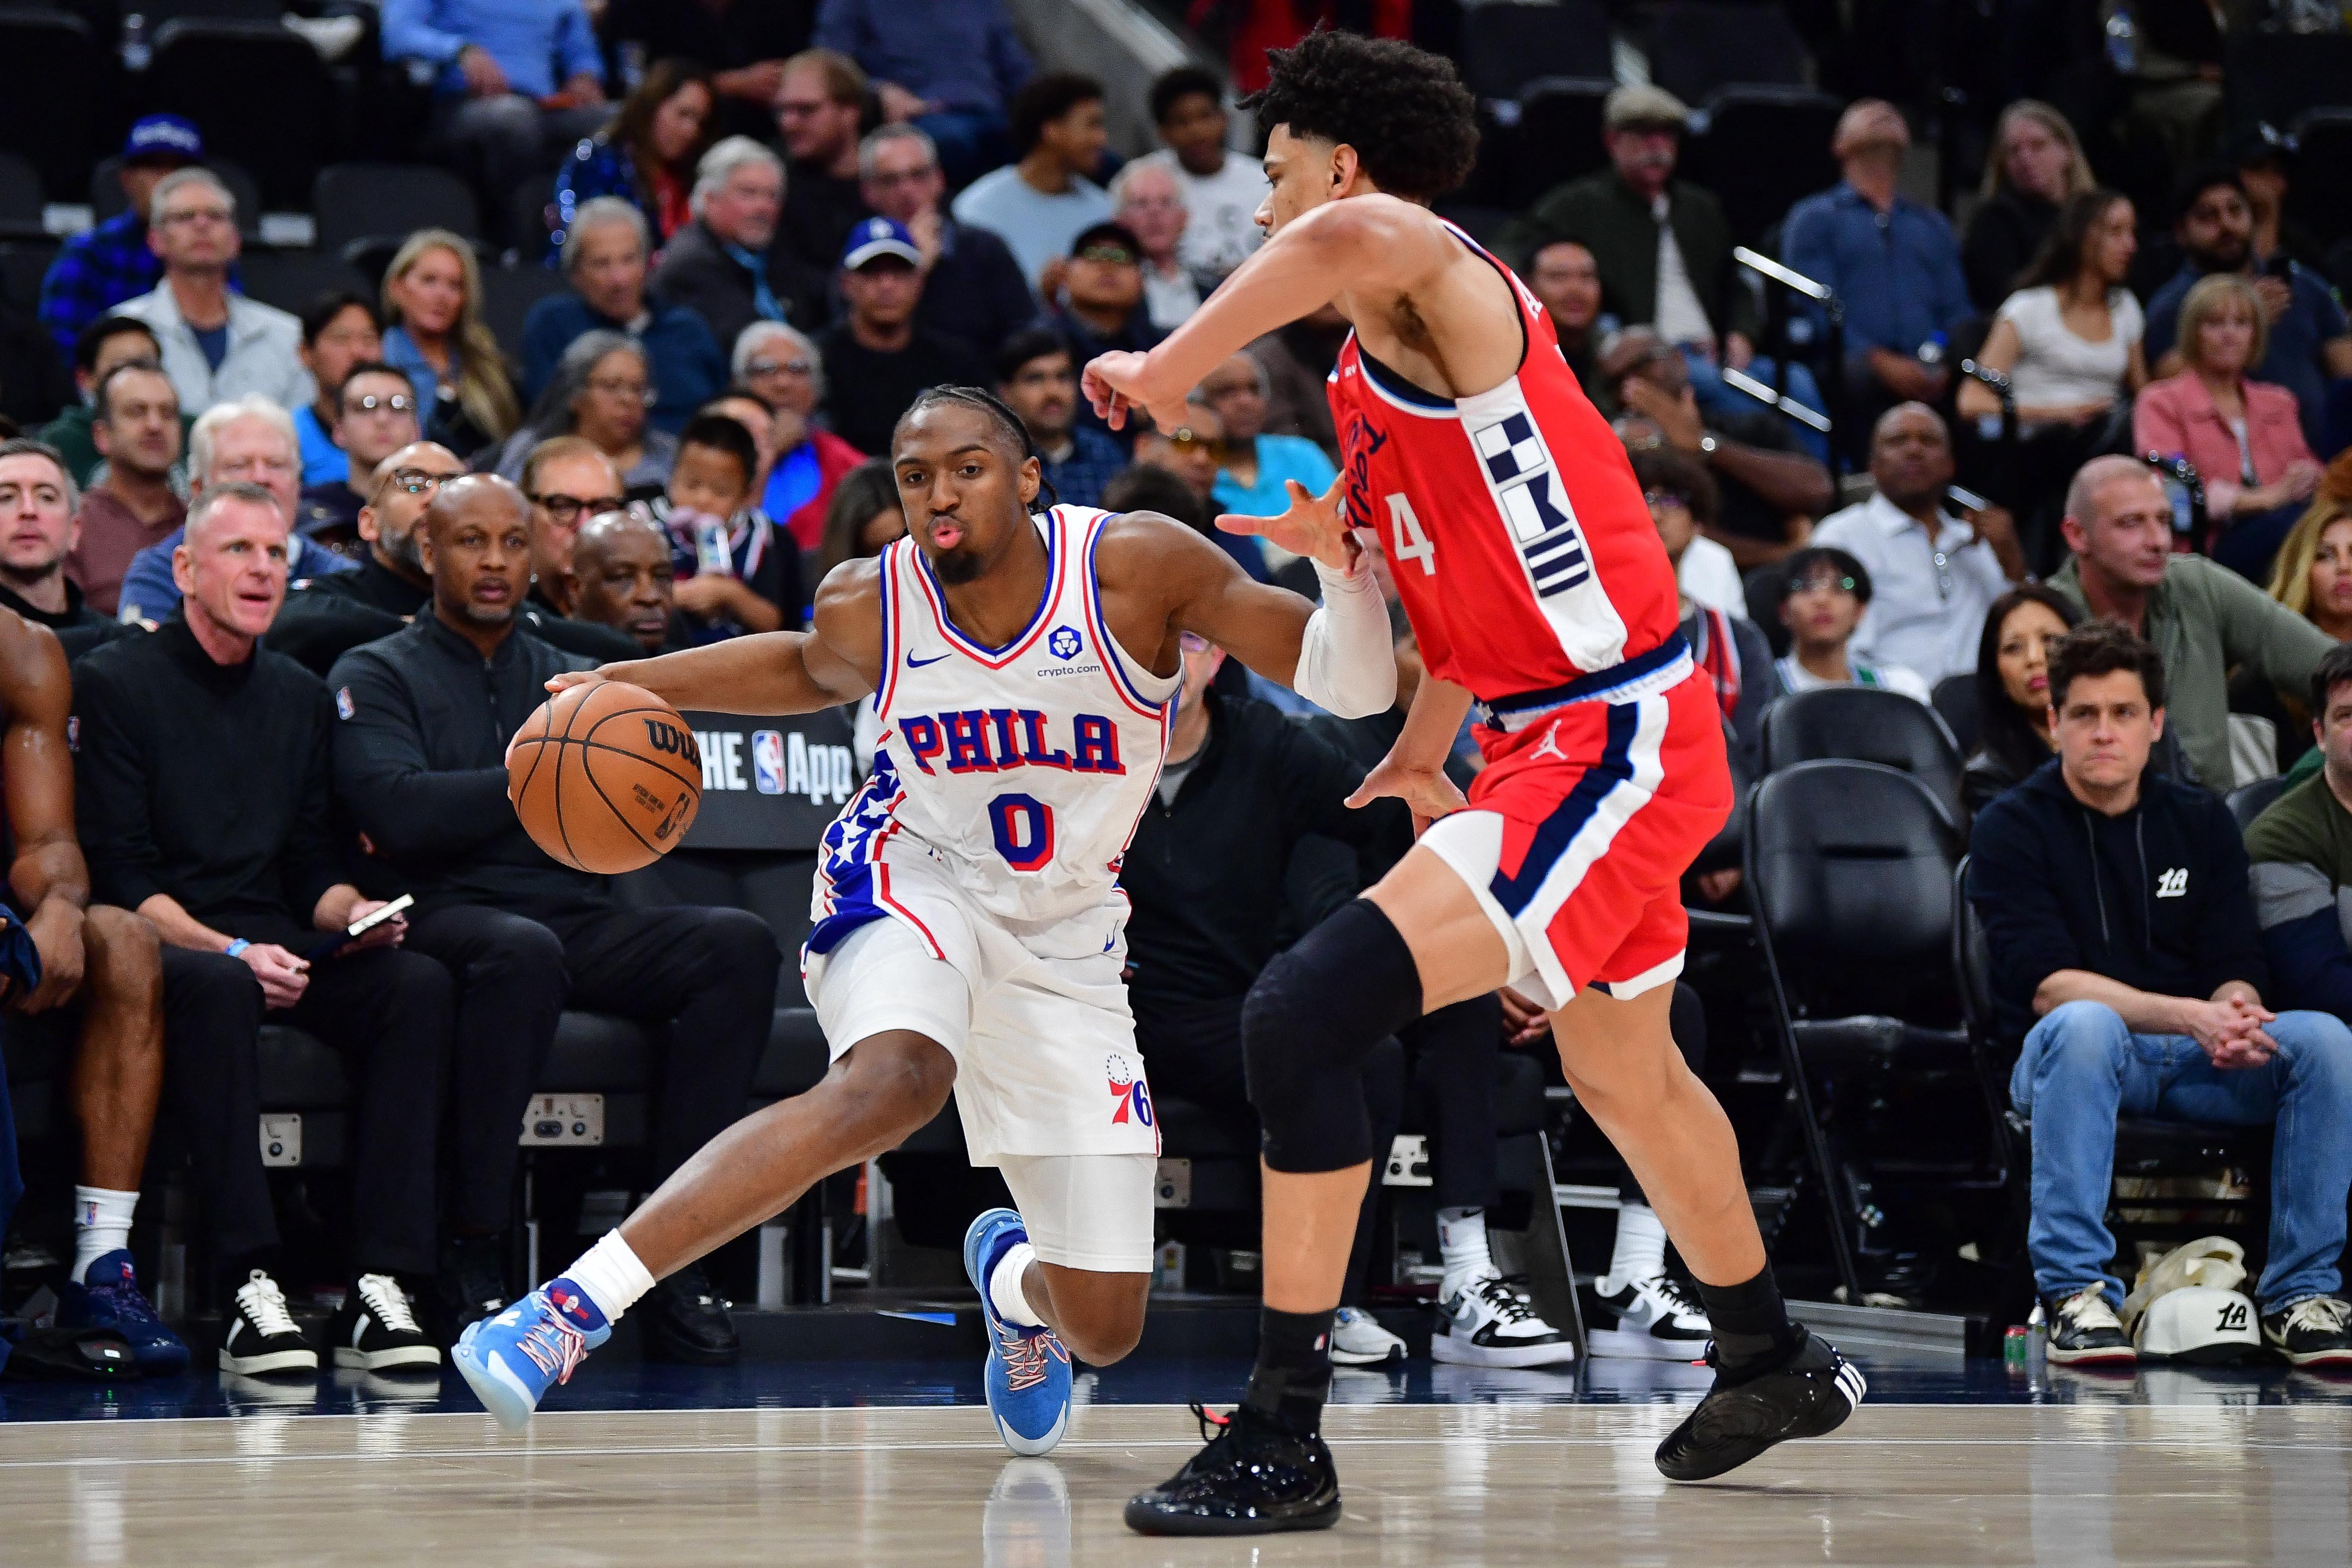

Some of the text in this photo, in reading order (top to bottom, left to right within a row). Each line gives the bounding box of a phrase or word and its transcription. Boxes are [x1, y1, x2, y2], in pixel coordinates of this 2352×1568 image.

[1384, 491, 1436, 576] 4
[1037, 665, 1101, 677] crypto.com
[691, 731, 854, 806] HE App
[898, 708, 1127, 776] PHILA
[987, 793, 1055, 872] 0
[2155, 867, 2189, 898] LA
[1108, 1078, 1153, 1127] 76
[2216, 1301, 2247, 1331] LA
